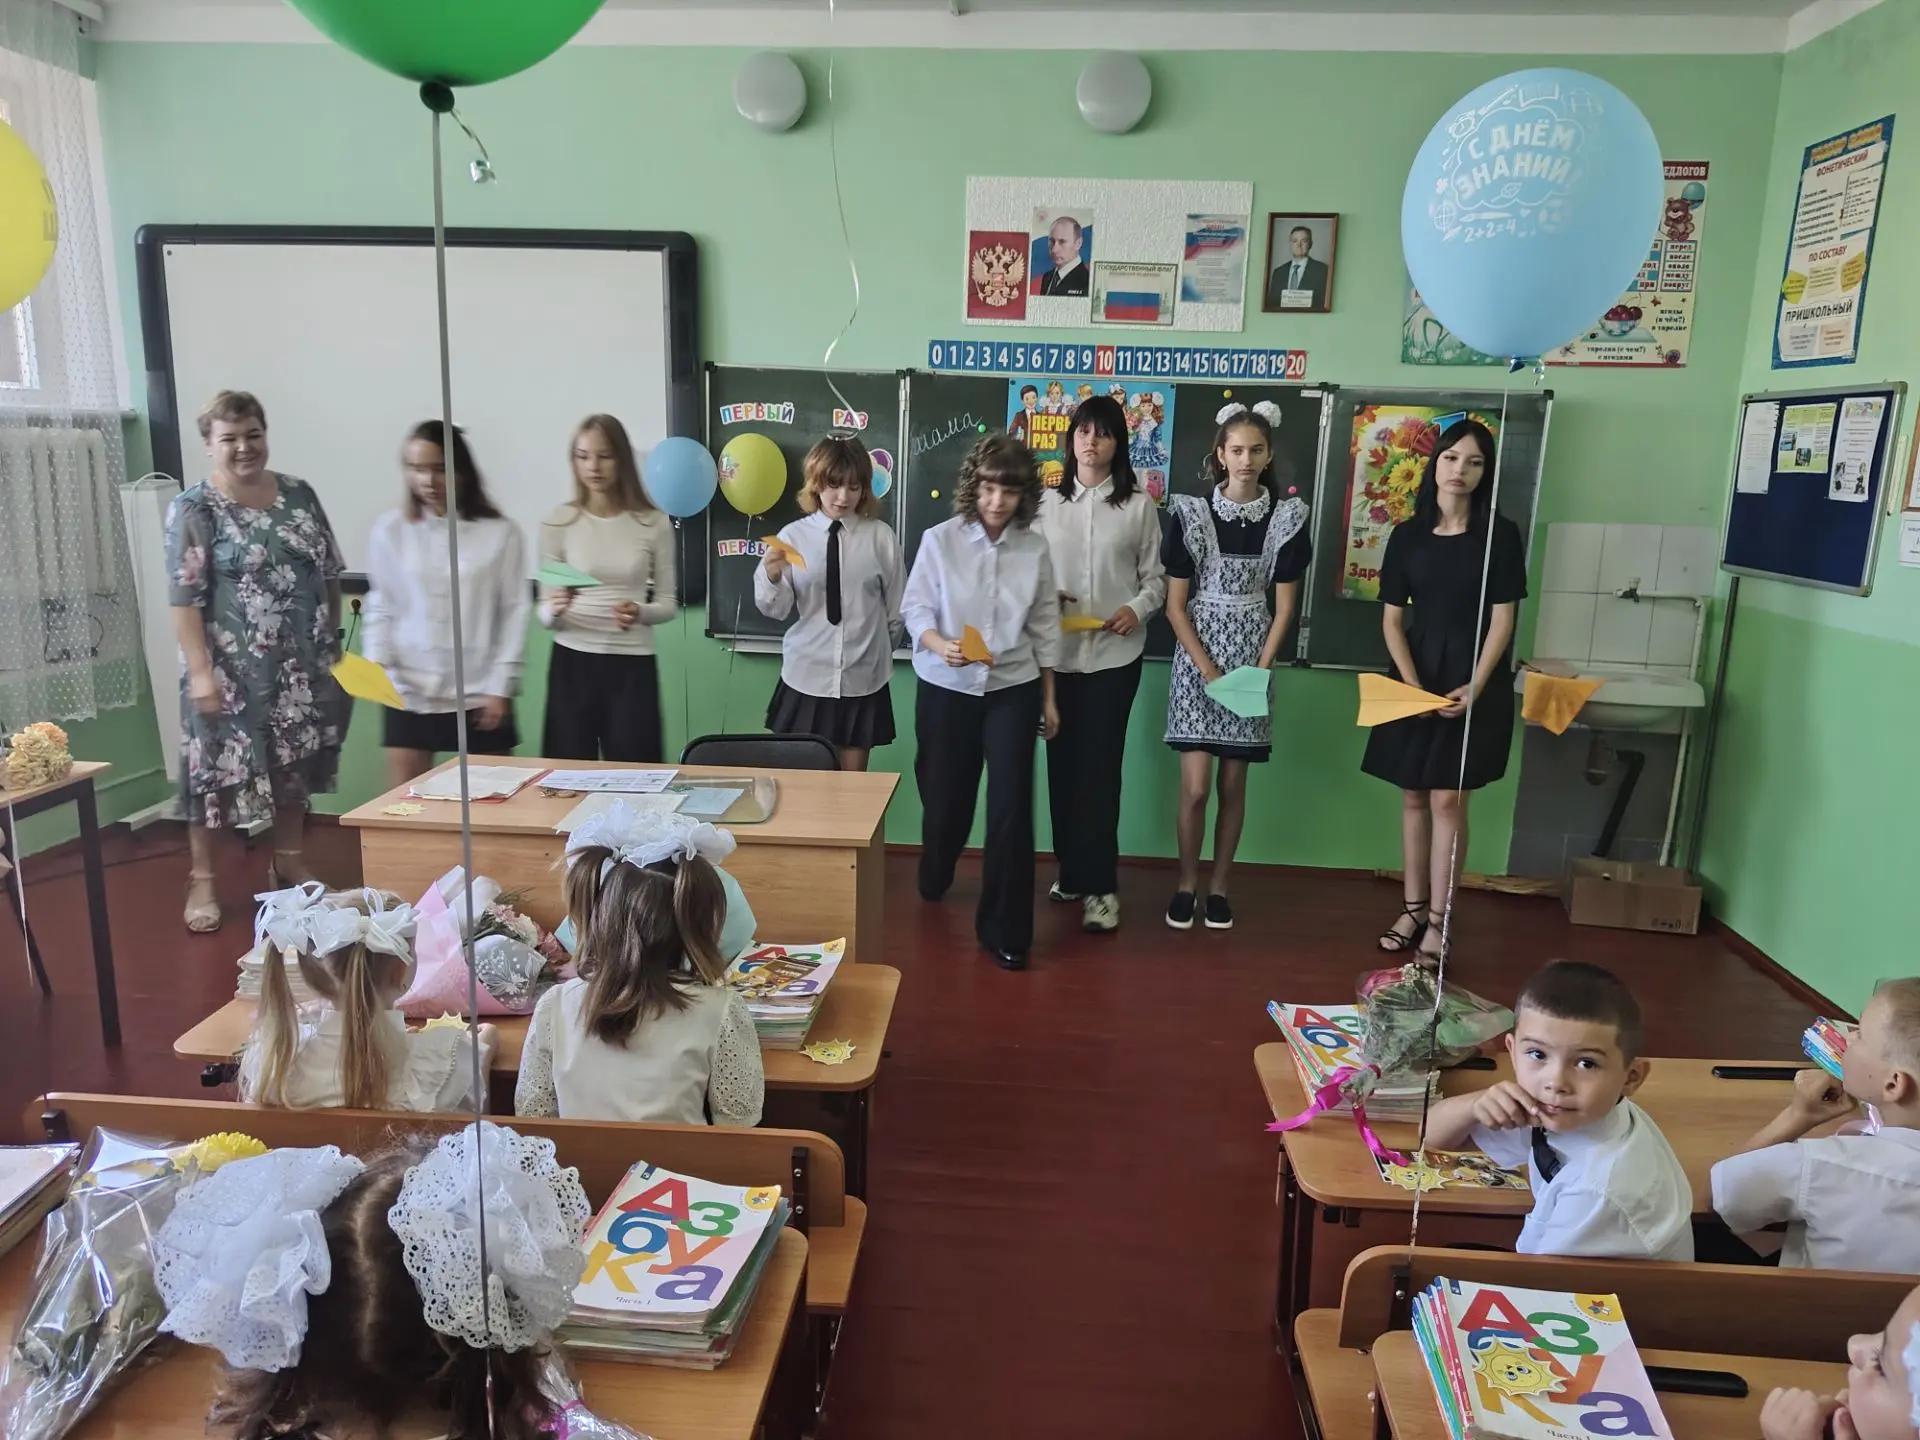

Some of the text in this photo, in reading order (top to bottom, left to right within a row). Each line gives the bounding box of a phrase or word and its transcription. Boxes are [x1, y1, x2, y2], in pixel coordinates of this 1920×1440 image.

[1468, 119, 1576, 159] С ДНЁМ
[1664, 166, 1706, 178] ЕДЛОГОВ
[1785, 299, 1853, 322] ПРИШКОЛЬНЫЙ
[932, 344, 1306, 375] 0 1 2 3 4 5 6 7 8 9 10 11 12 13 14 15 16 17 18 19 20
[721, 402, 793, 424] ПЕРВЫЙ
[834, 409, 868, 429] РАЗ
[1032, 415, 1070, 431] ПЕРВ
[1032, 433, 1057, 449] РАЗ
[719, 540, 768, 555] ПЕРВЫ
